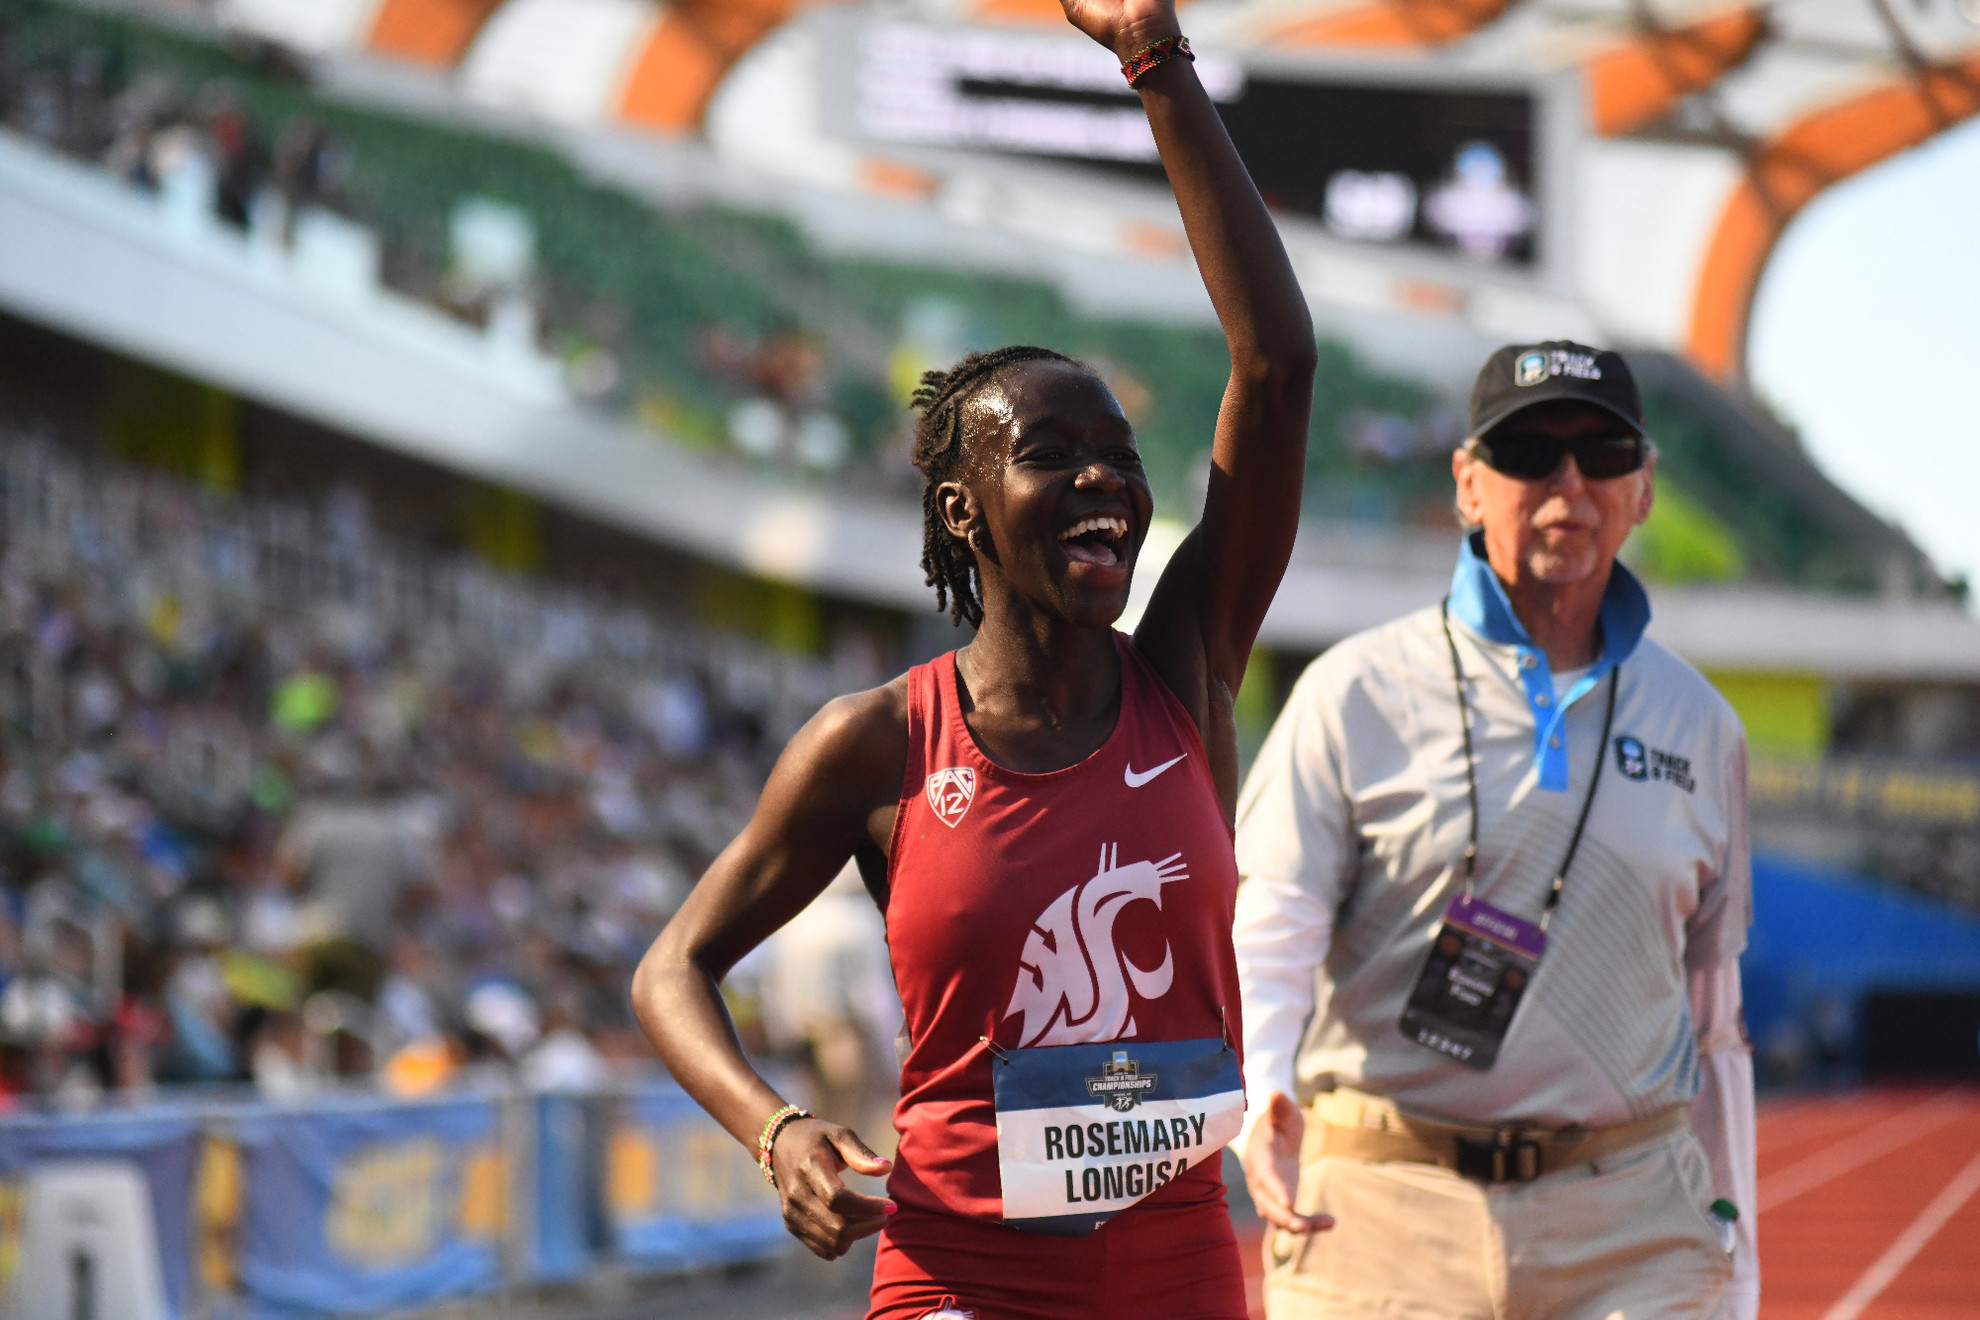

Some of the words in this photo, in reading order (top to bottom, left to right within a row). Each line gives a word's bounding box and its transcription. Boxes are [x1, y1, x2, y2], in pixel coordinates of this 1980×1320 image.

[929, 769, 973, 806] PAC
[940, 792, 965, 816] 12
[1092, 1079, 1152, 1092] CHAMPIONSHIPS
[1044, 1112, 1206, 1161] ROSEMARY
